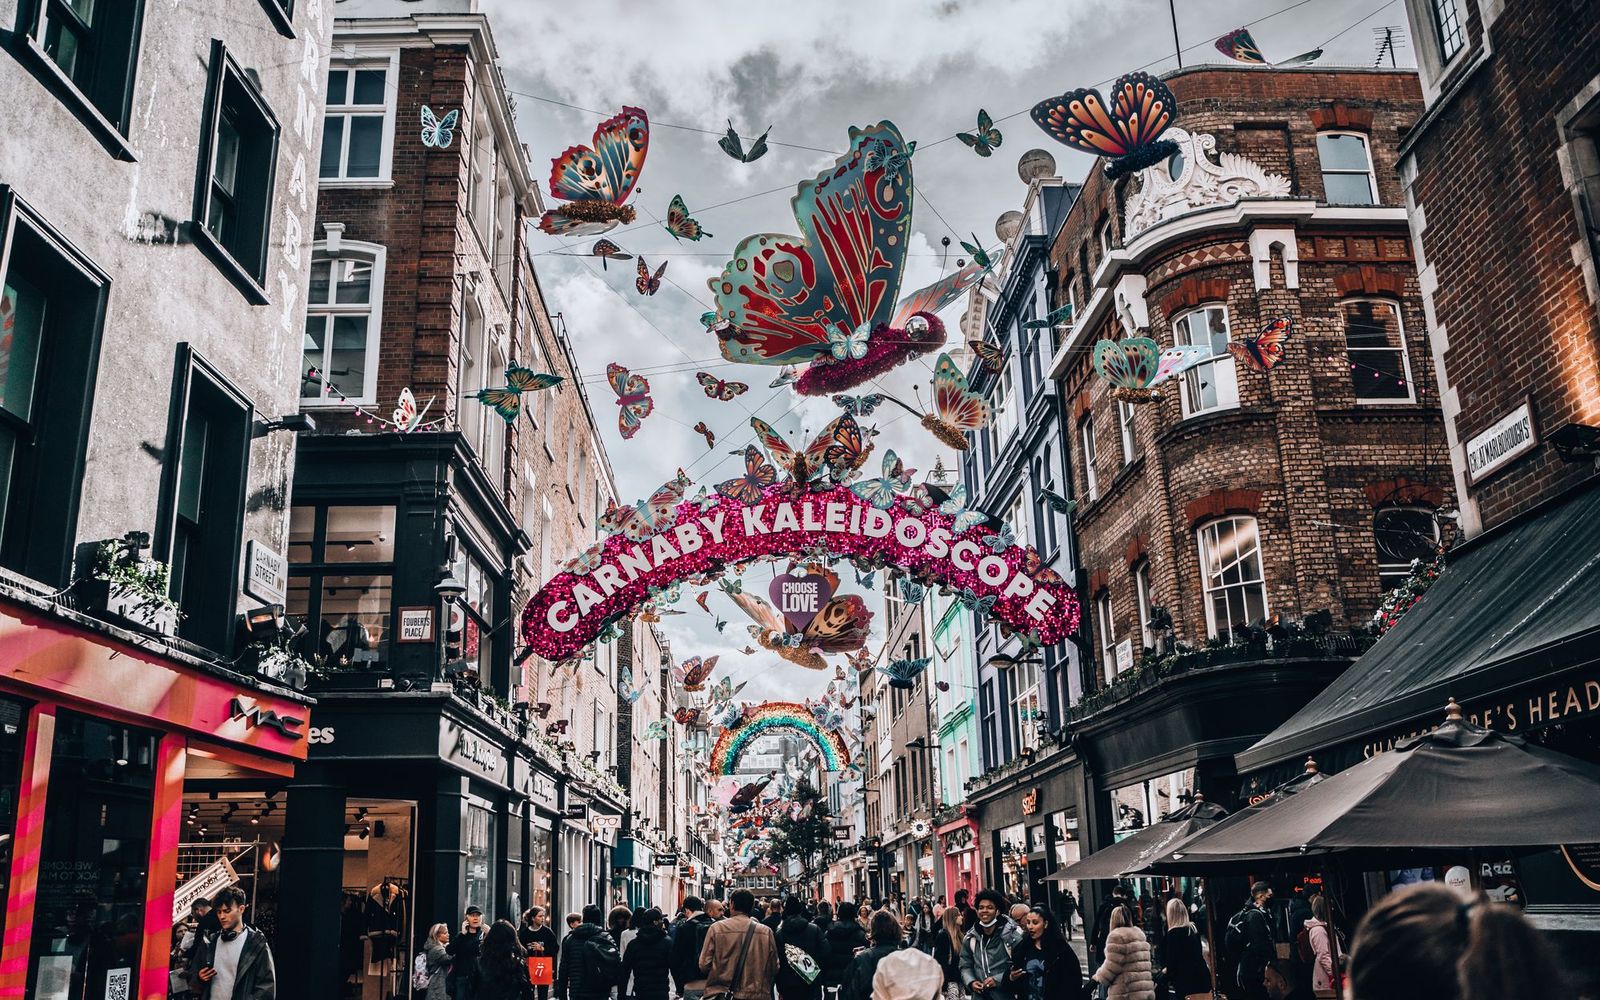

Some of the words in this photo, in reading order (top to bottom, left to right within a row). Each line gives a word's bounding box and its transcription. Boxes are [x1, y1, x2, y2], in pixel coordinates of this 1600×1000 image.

[256, 548, 280, 574] CARNABY
[547, 512, 725, 633] CARNABY
[741, 501, 1057, 621] KALEIDOSCOPE
[255, 563, 275, 586] STREET
[782, 582, 818, 594] CHOOSE
[782, 594, 819, 613] LOVE
[404, 628, 422, 637] PLACE
[1529, 680, 1600, 725] HEAD
[230, 698, 305, 740] MAC
